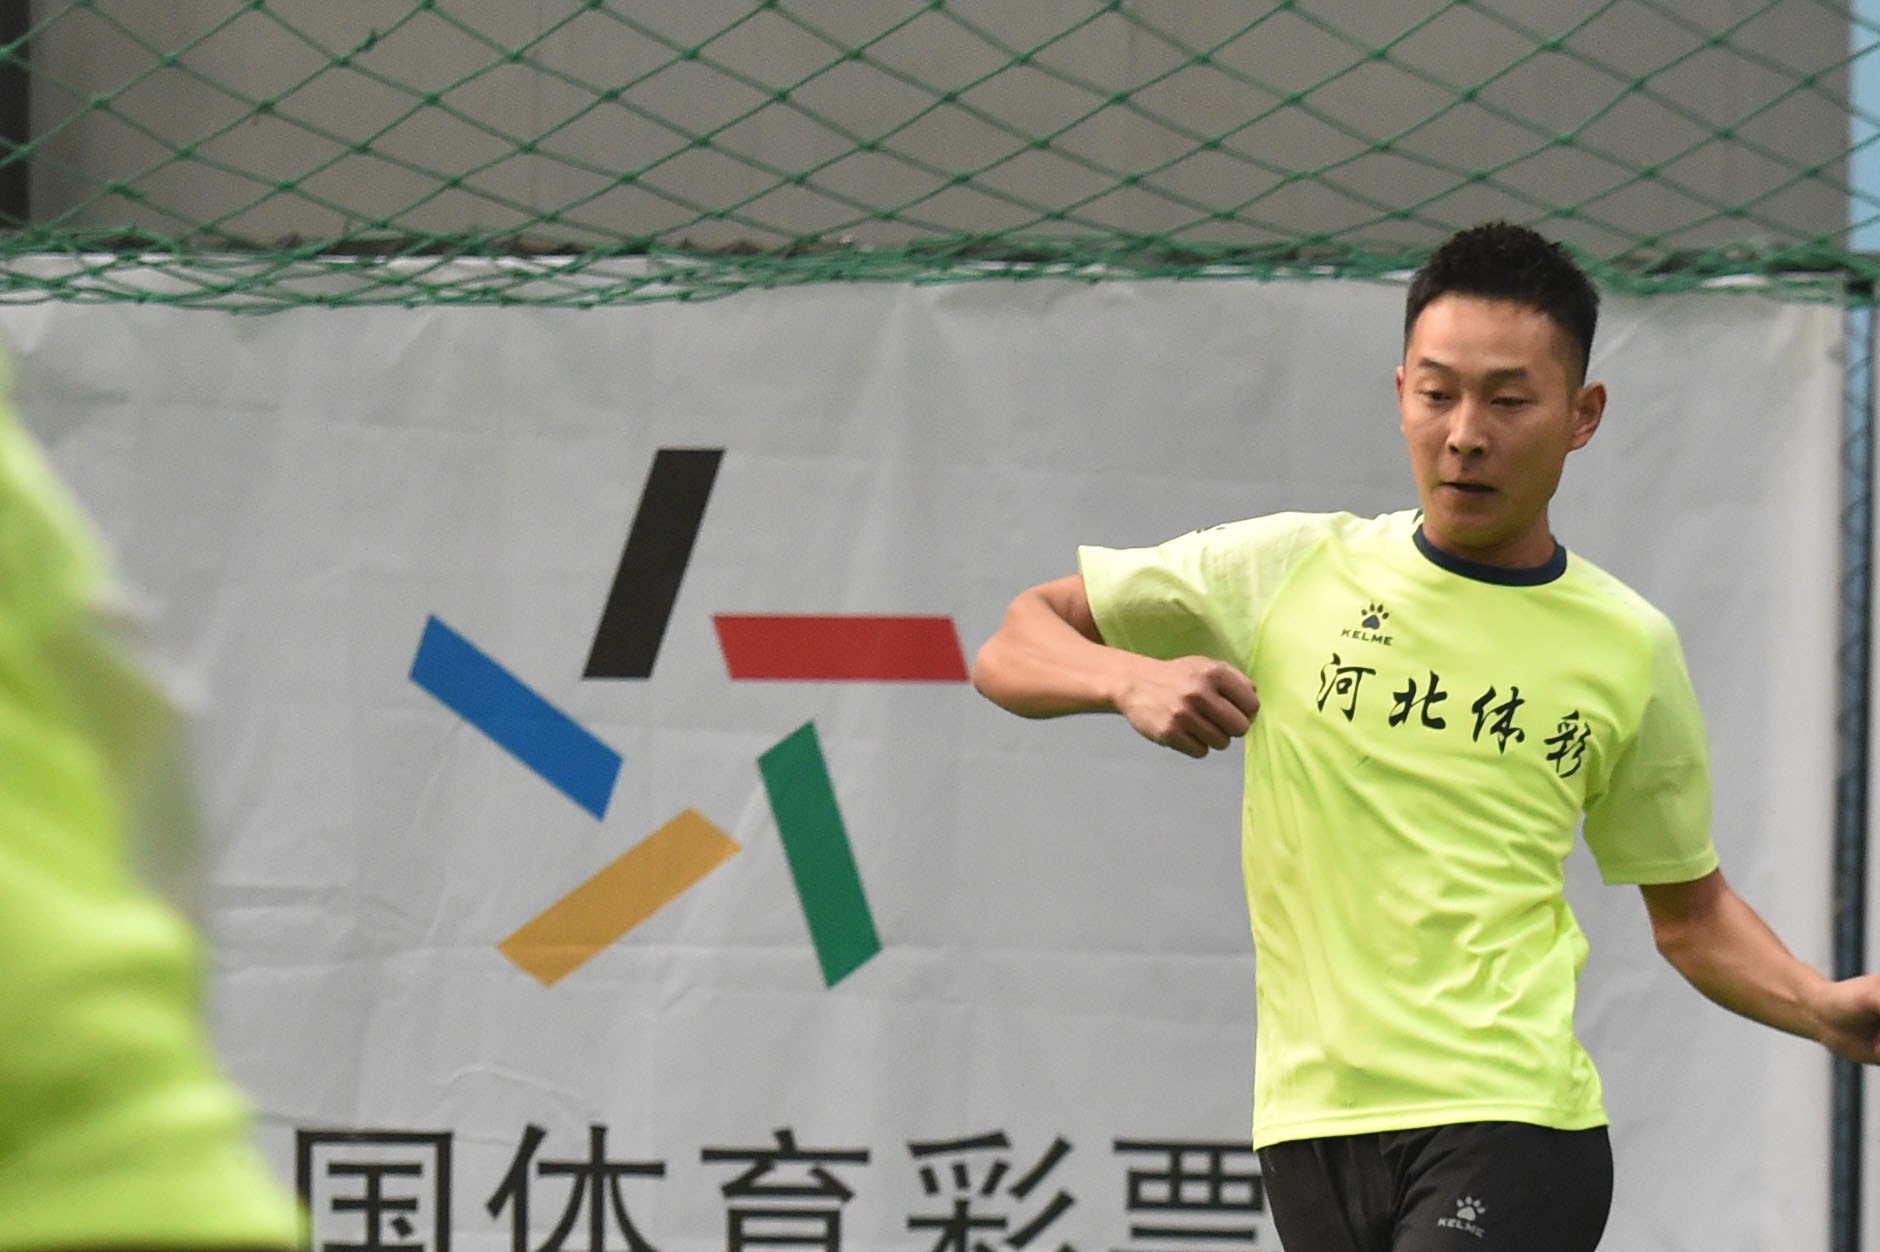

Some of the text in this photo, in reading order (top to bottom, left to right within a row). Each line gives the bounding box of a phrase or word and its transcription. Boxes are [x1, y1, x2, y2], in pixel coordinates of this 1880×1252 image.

[1341, 628, 1393, 646] KELME
[1316, 652, 1592, 779] 河北体彩
[1437, 1217, 1486, 1238] KELME
